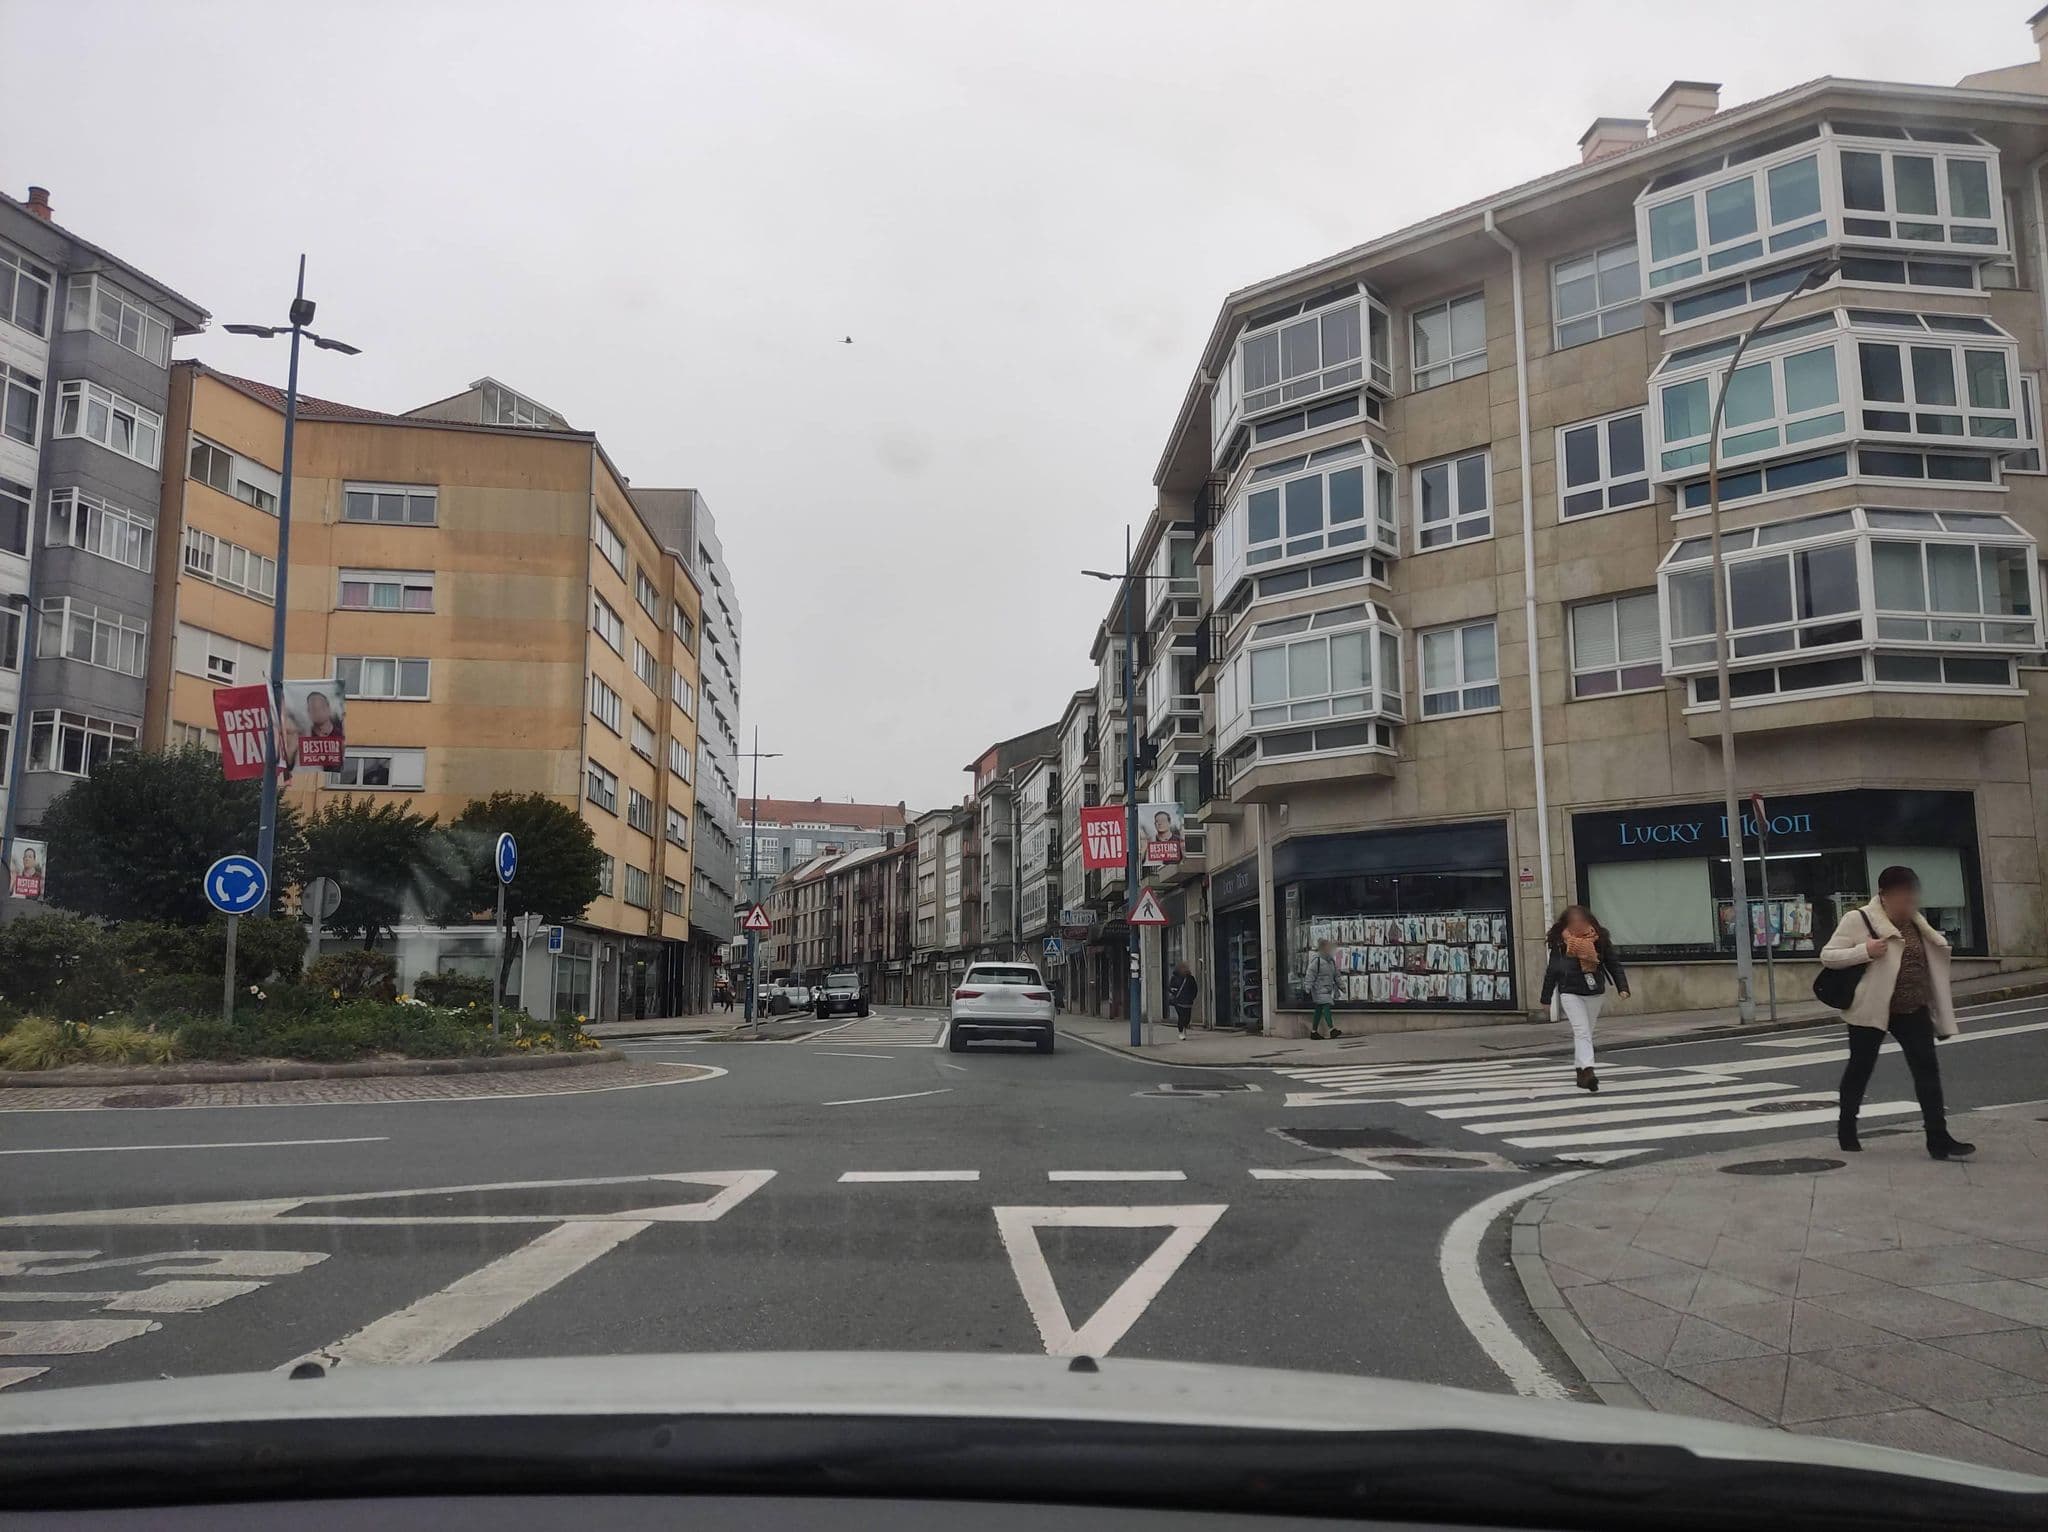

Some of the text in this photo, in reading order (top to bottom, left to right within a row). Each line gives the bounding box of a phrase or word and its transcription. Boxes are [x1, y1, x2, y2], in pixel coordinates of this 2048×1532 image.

[223, 708, 268, 732] DESTA
[227, 730, 268, 765] VAI
[1087, 821, 1121, 837] DESTA
[1619, 822, 1704, 845] LUCKY
[1088, 835, 1122, 860] VAI!
